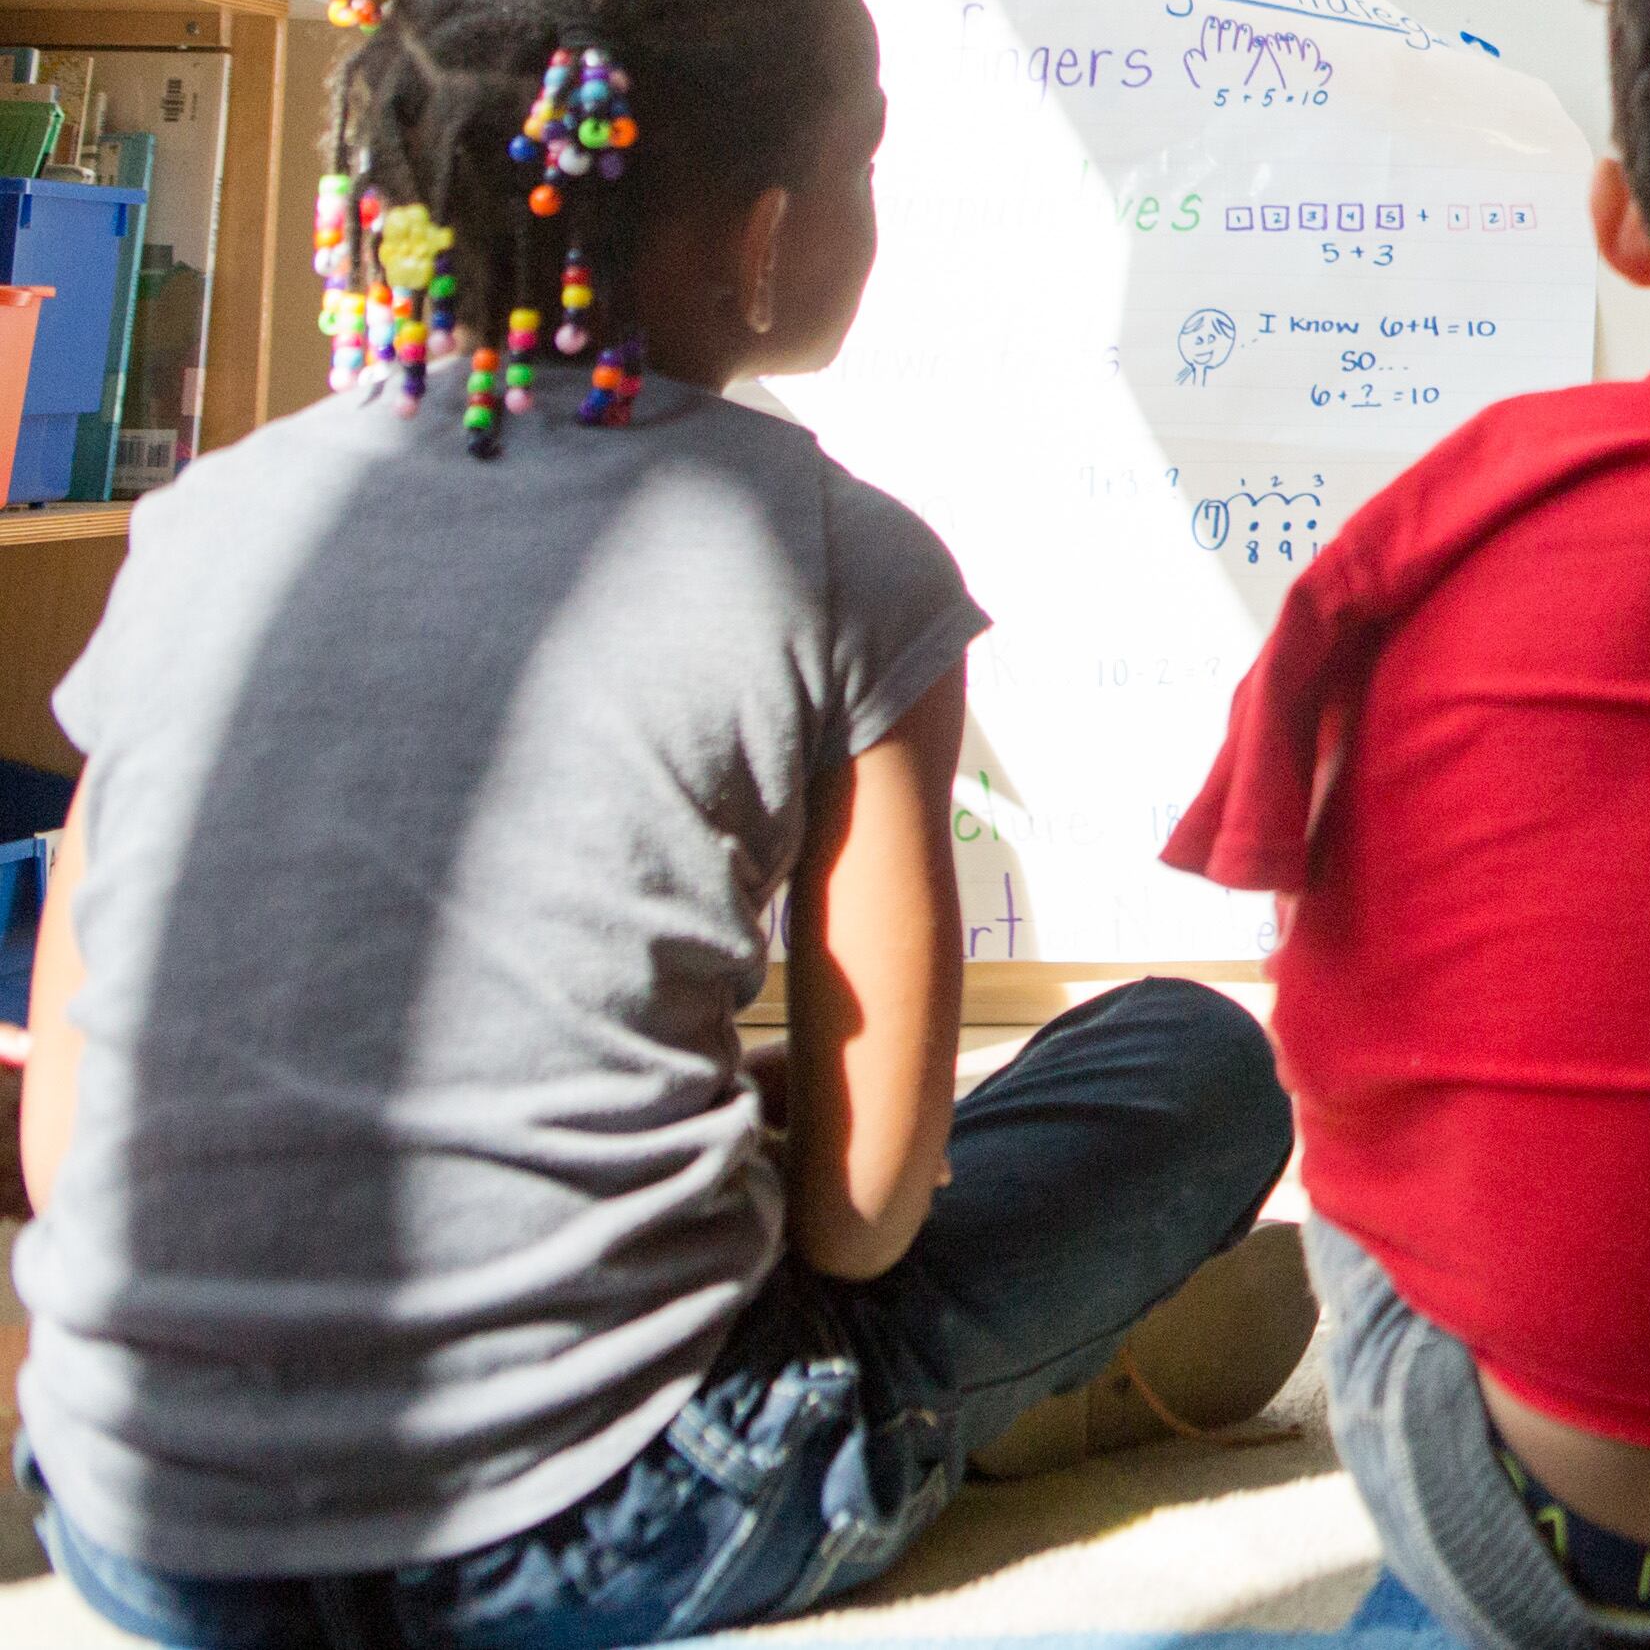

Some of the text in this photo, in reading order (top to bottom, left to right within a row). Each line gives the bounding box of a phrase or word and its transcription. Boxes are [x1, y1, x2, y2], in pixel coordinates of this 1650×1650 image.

[1321, 243, 1395, 266] 5 3
[1257, 313, 1277, 335] I
[1290, 315, 1360, 335] know
[1245, 540, 1293, 565] 8 9
